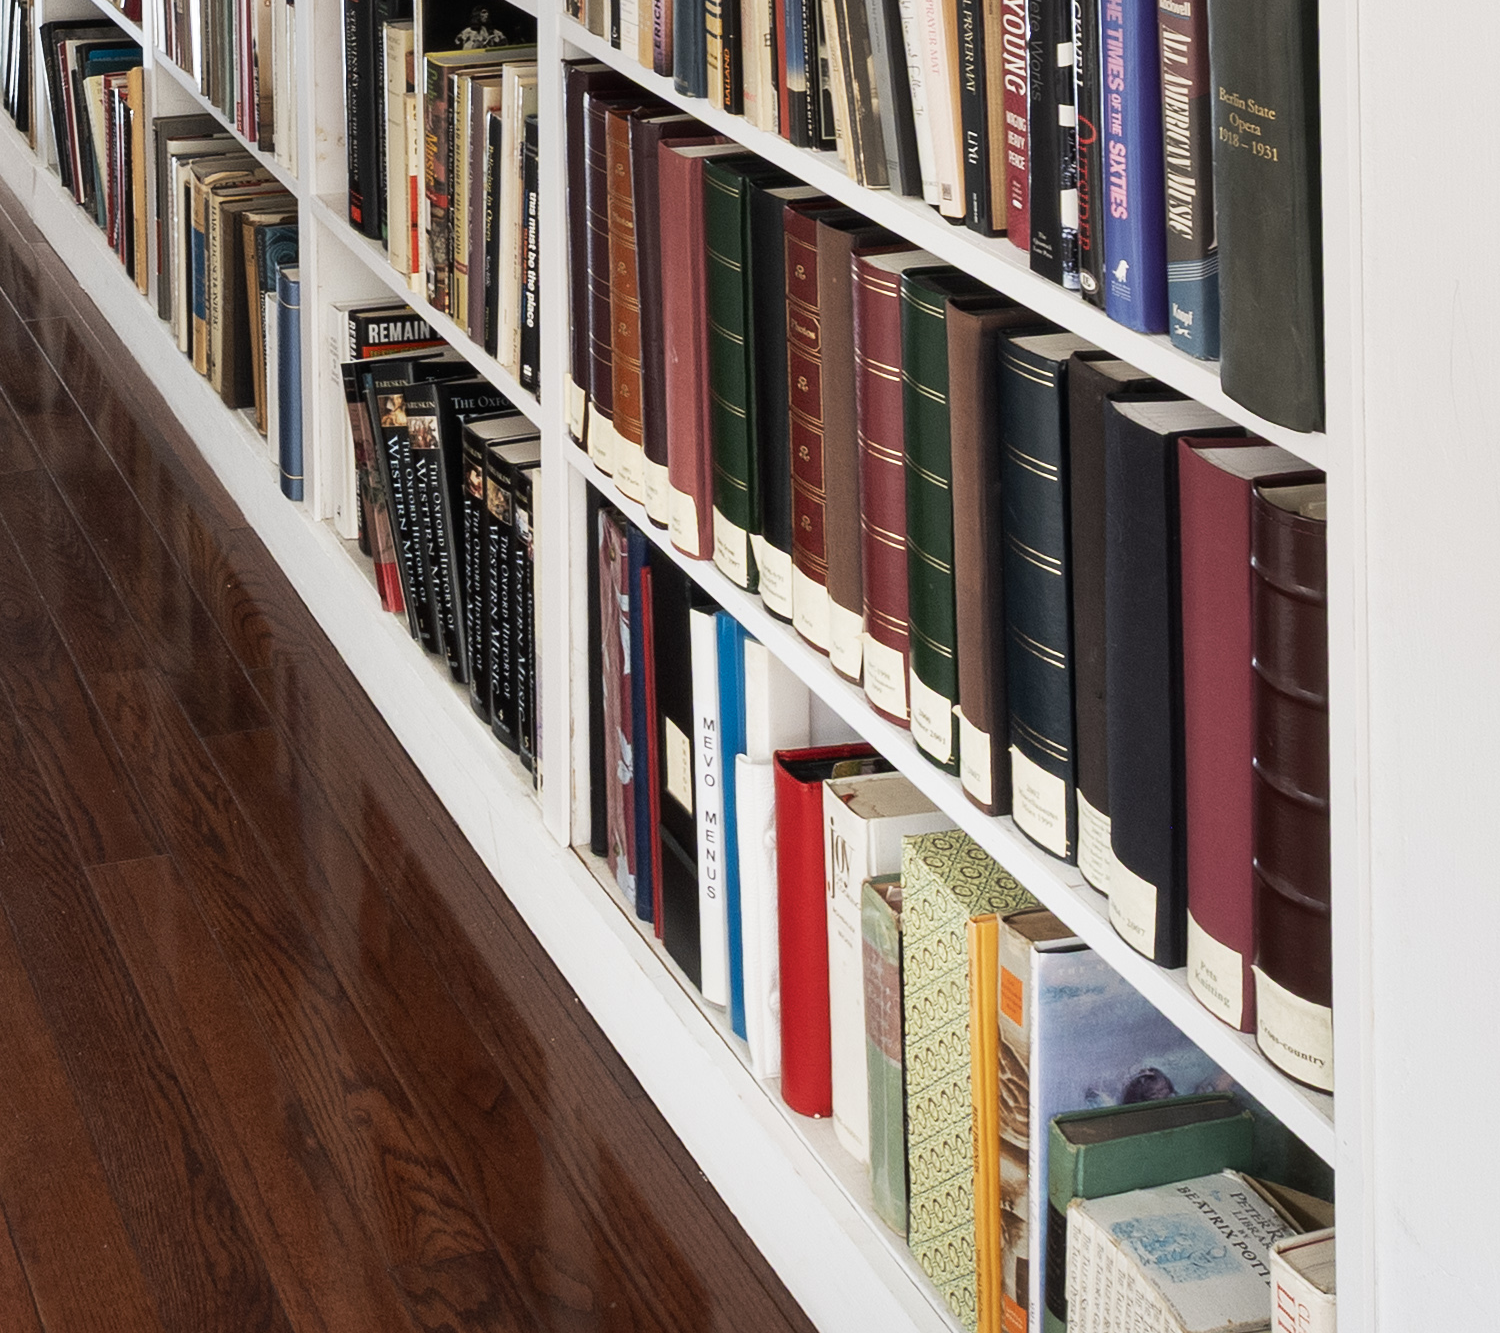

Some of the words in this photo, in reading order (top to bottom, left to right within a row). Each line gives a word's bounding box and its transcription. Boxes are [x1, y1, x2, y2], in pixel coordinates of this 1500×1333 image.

[1219, 86, 1245, 109] Berlin
[1247, 95, 1277, 121] State
[1230, 114, 1262, 137] Opera
[368, 320, 432, 344] REMAIN
[703, 716, 717, 789] MEVO
[704, 810, 717, 900] MENUS
